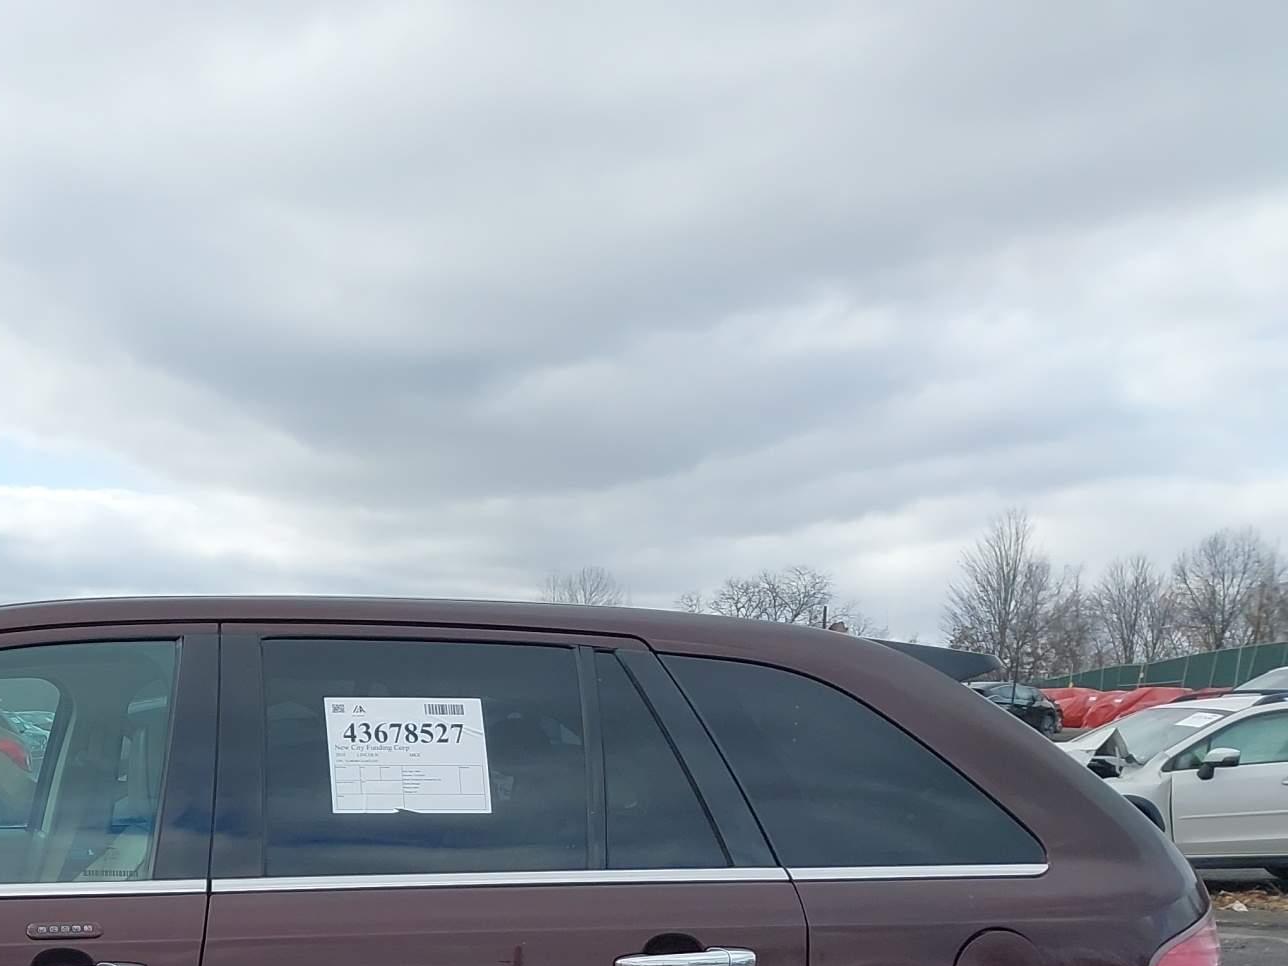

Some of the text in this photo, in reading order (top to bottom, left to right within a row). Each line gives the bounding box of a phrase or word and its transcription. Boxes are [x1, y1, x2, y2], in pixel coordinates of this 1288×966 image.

[343, 722, 464, 744] 43678527
[351, 744, 364, 752] City
[366, 744, 392, 752] Funding
